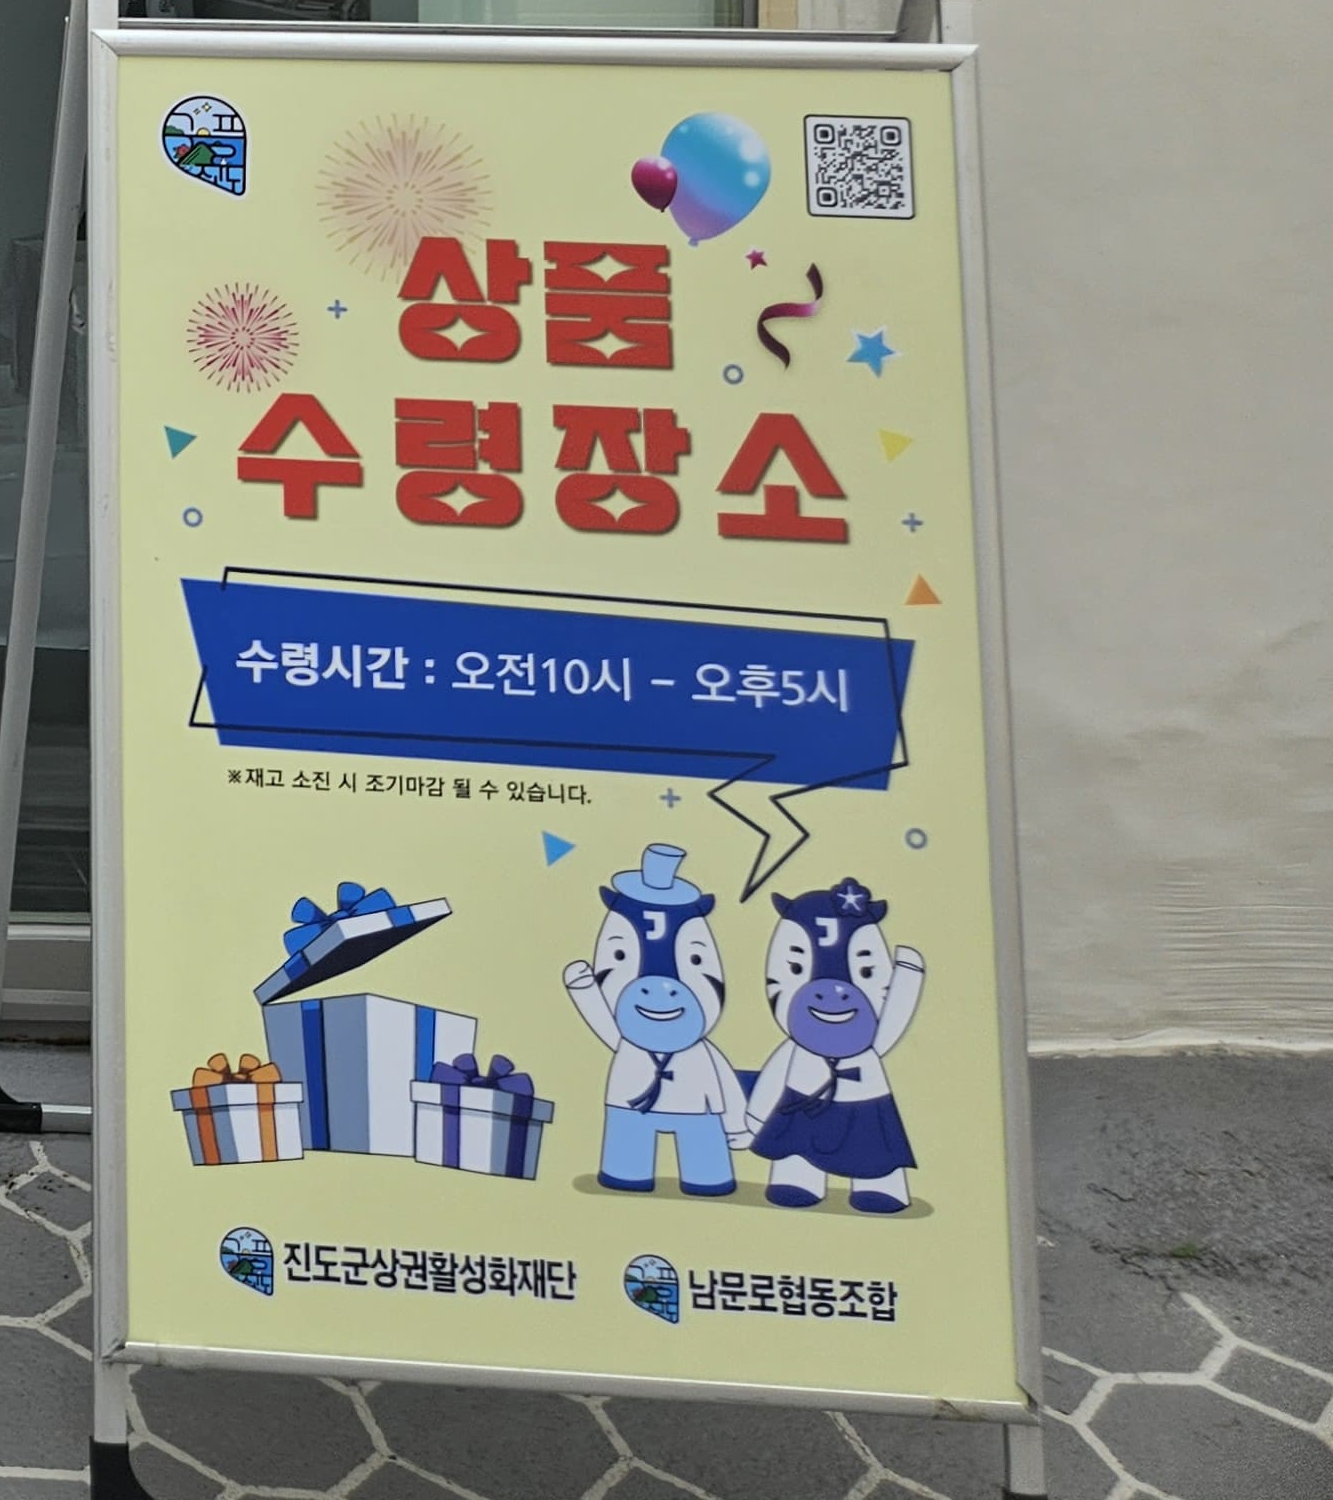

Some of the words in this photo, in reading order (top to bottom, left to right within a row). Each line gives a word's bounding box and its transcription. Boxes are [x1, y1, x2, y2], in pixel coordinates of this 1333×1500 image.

[398, 236, 674, 370] 상품
[236, 392, 849, 544] 수령장소
[234, 638, 410, 690] 수령시간
[451, 650, 633, 702] 오전10시
[690, 661, 850, 712] 오후5시
[292, 768, 332, 793] 소진
[338, 770, 359, 794] 시
[363, 772, 446, 799] 조기마감
[451, 776, 472, 800] 될
[478, 778, 500, 802] 수
[505, 778, 593, 806] 있습니다.
[283, 1240, 577, 1302] 진도군상권활성화재단
[687, 1268, 899, 1324] 남문로협동조합
